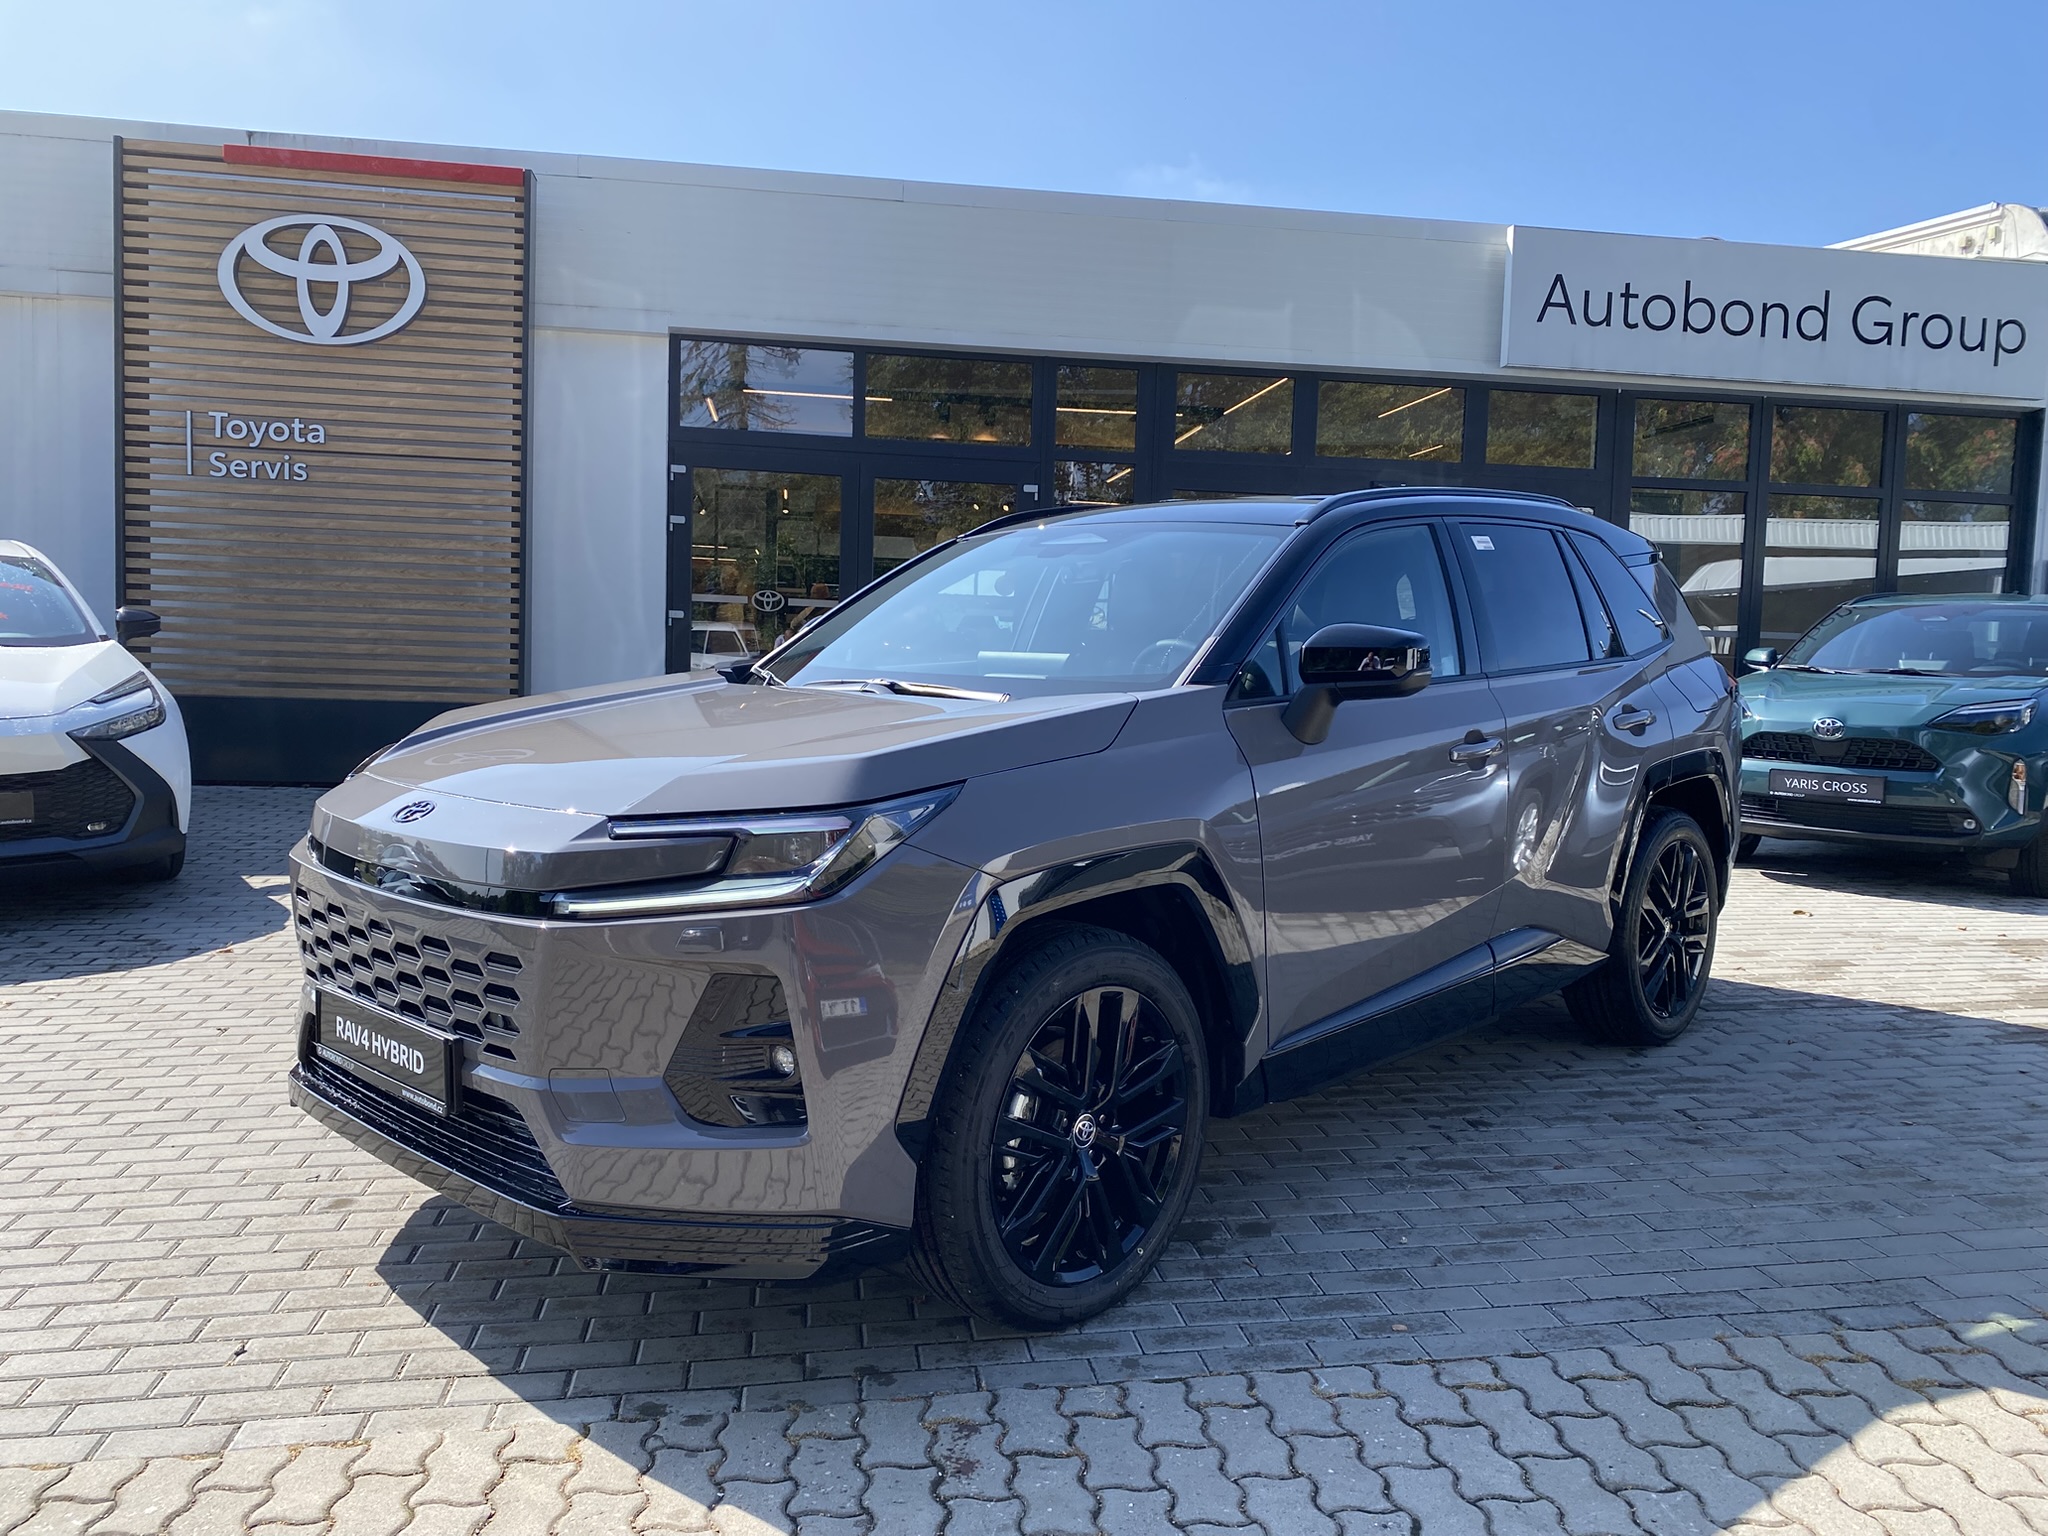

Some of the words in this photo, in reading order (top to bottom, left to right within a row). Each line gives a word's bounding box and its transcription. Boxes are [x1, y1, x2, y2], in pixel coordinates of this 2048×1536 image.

[1536, 273, 1831, 342] Autobond
[1851, 295, 2027, 367] Group
[208, 411, 326, 448] Toyota
[209, 451, 308, 481] Servis
[1784, 777, 1819, 790] YARIS
[1822, 780, 1868, 794] CROSS
[336, 1015, 369, 1051] RAV4
[372, 1031, 425, 1075] HYBRID
